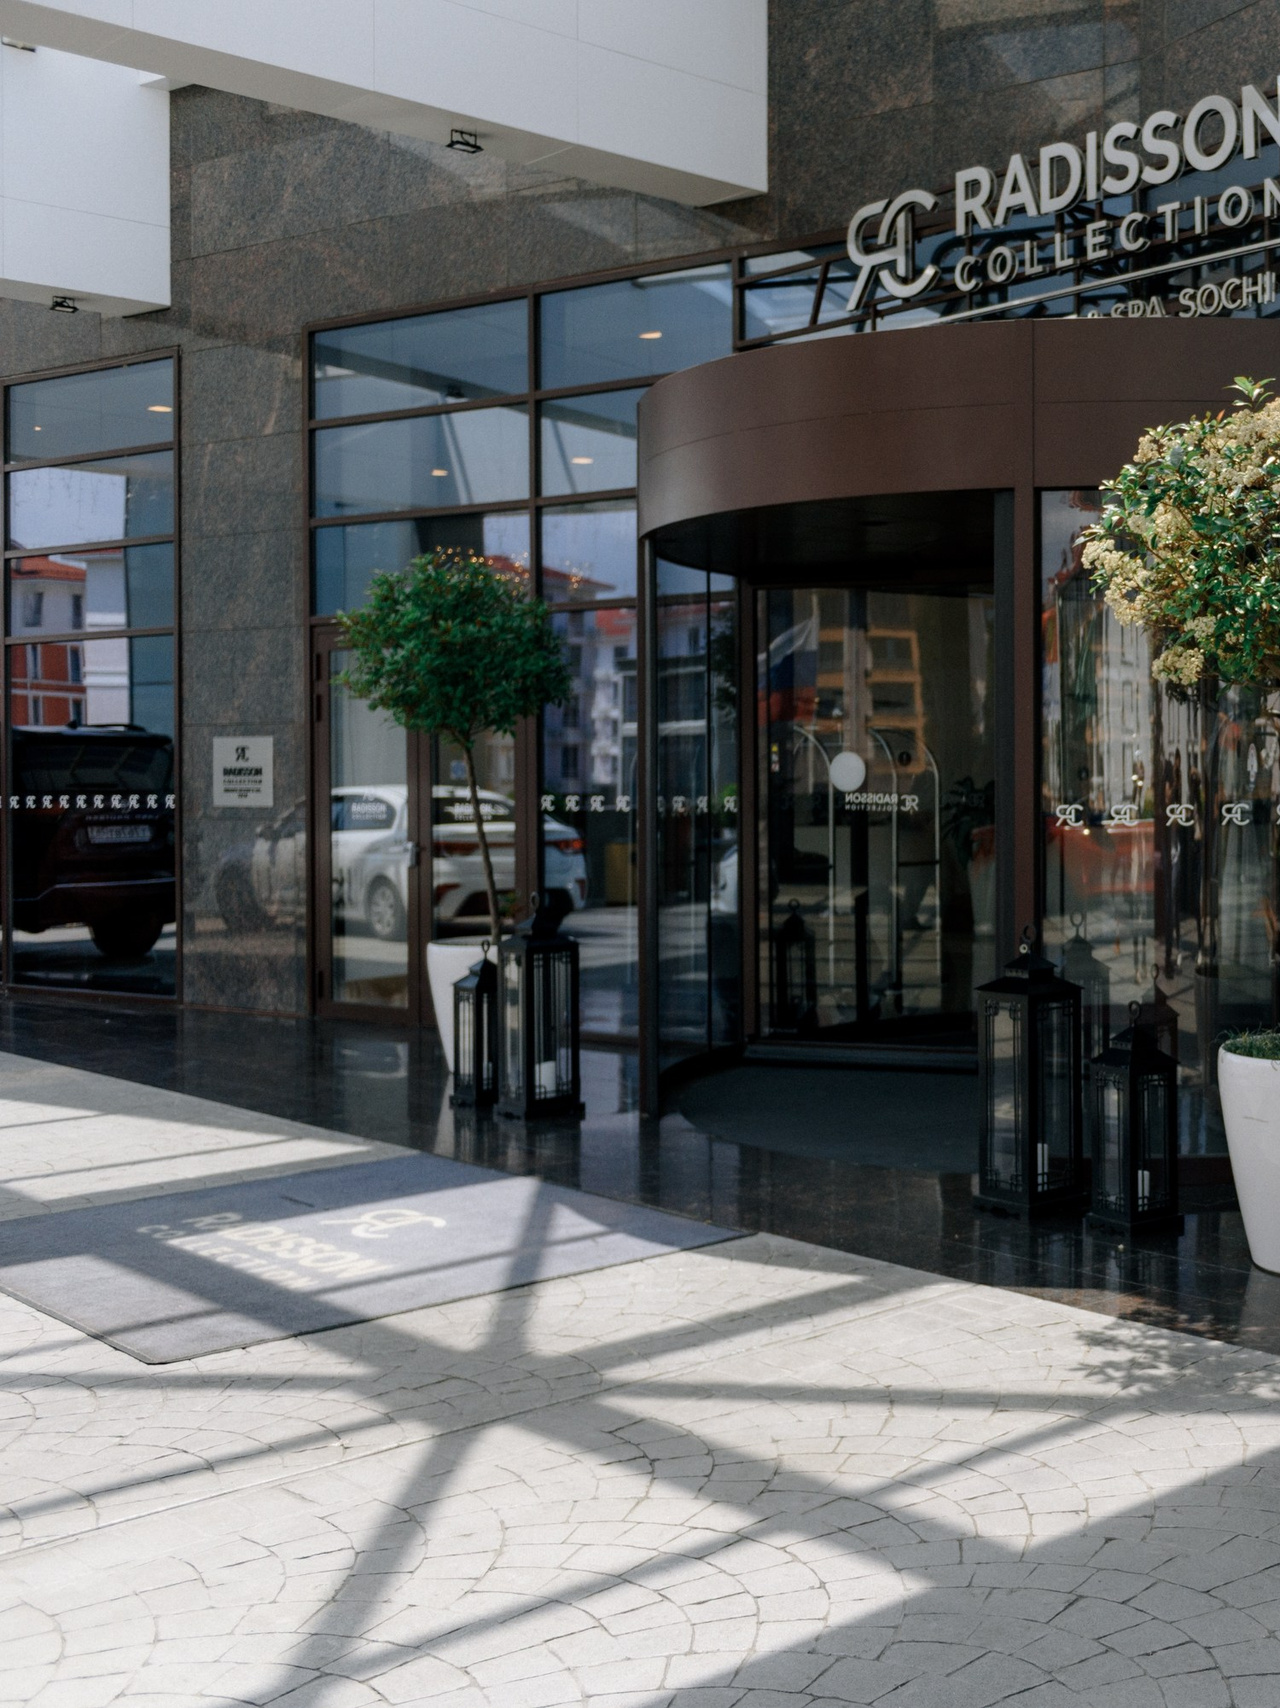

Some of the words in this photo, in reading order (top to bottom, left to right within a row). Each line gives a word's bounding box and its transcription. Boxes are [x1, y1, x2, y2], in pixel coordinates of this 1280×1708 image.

[1178, 271, 1276, 318] SOCHI
[136, 1225, 320, 1290] COLLECTION
[182, 1212, 394, 1279] RADISSON
